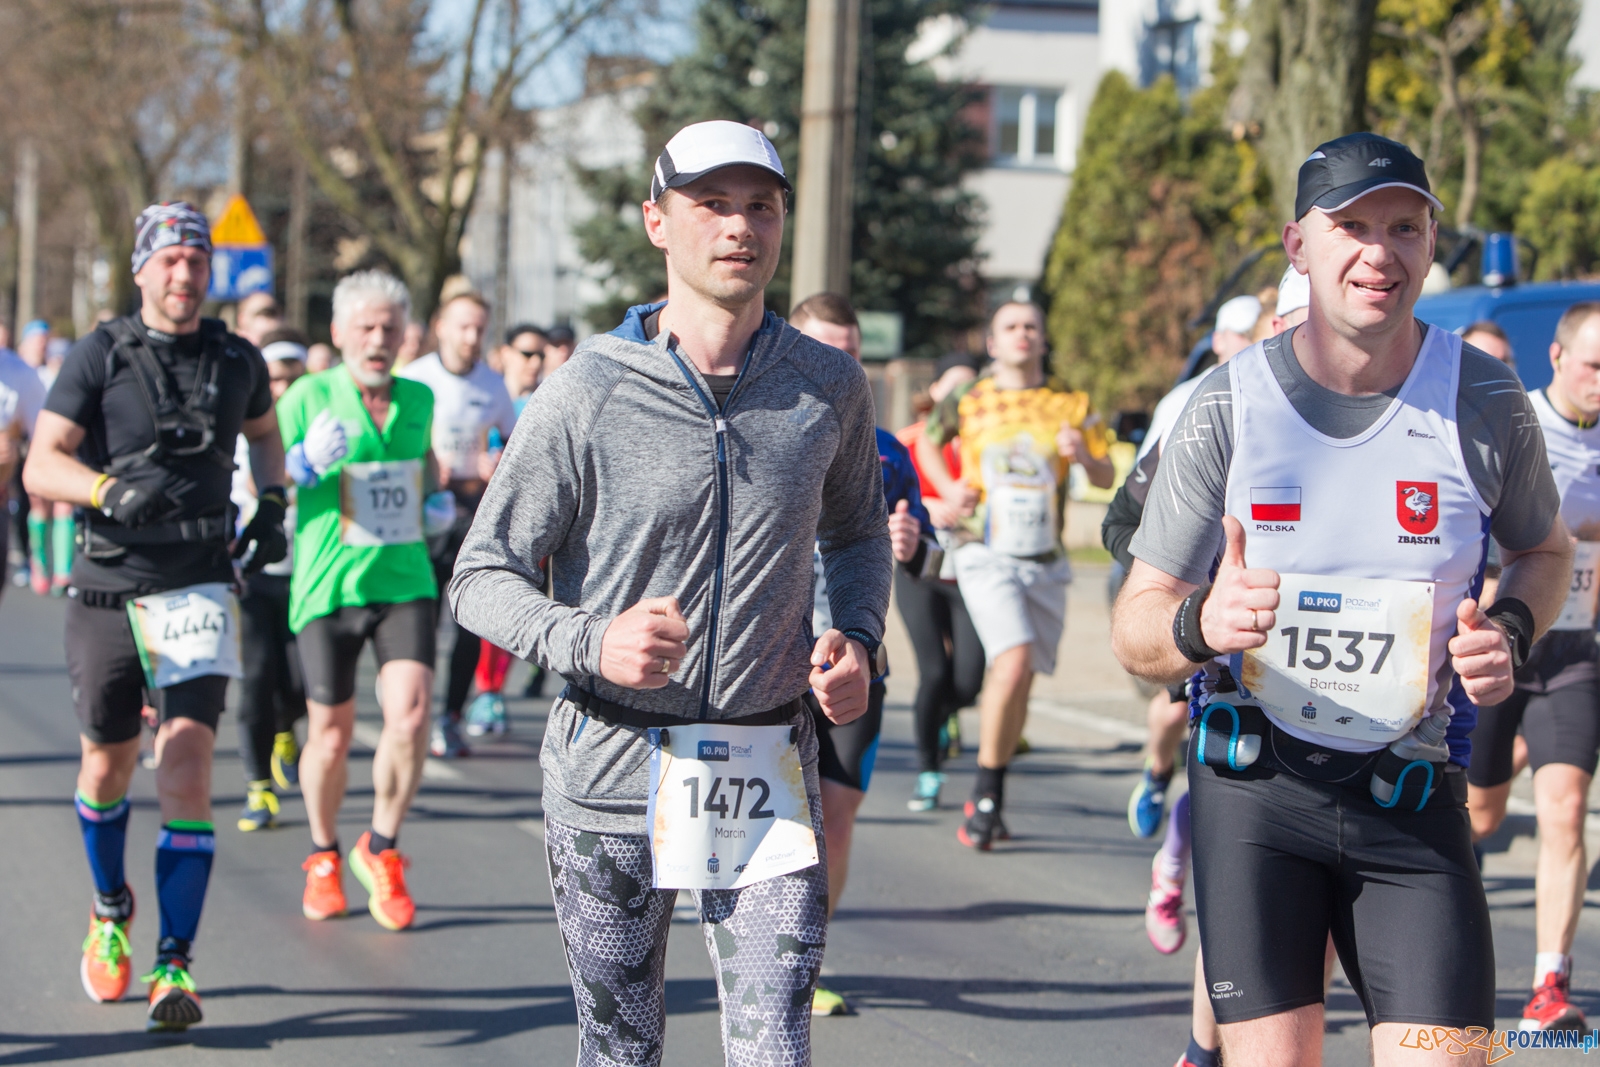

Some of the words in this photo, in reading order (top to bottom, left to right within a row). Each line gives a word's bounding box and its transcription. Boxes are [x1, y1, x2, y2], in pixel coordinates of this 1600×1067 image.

[1368, 157, 1392, 168] 4F
[368, 486, 408, 510] 170
[1256, 524, 1296, 532] POLSKA
[1397, 535, 1441, 545] ZBĄSZYŃ
[1302, 595, 1316, 607] 10.
[1316, 597, 1339, 609] PKO
[1280, 626, 1396, 675] 1537
[1309, 677, 1360, 693] Bartosz
[1335, 716, 1354, 725] 4F
[702, 745, 714, 756] 10.
[714, 746, 728, 756] PKO
[1306, 752, 1332, 766] 4F
[683, 776, 775, 820] 1472
[714, 827, 746, 839] Marcin
[1210, 989, 1244, 1000] Kalenji
